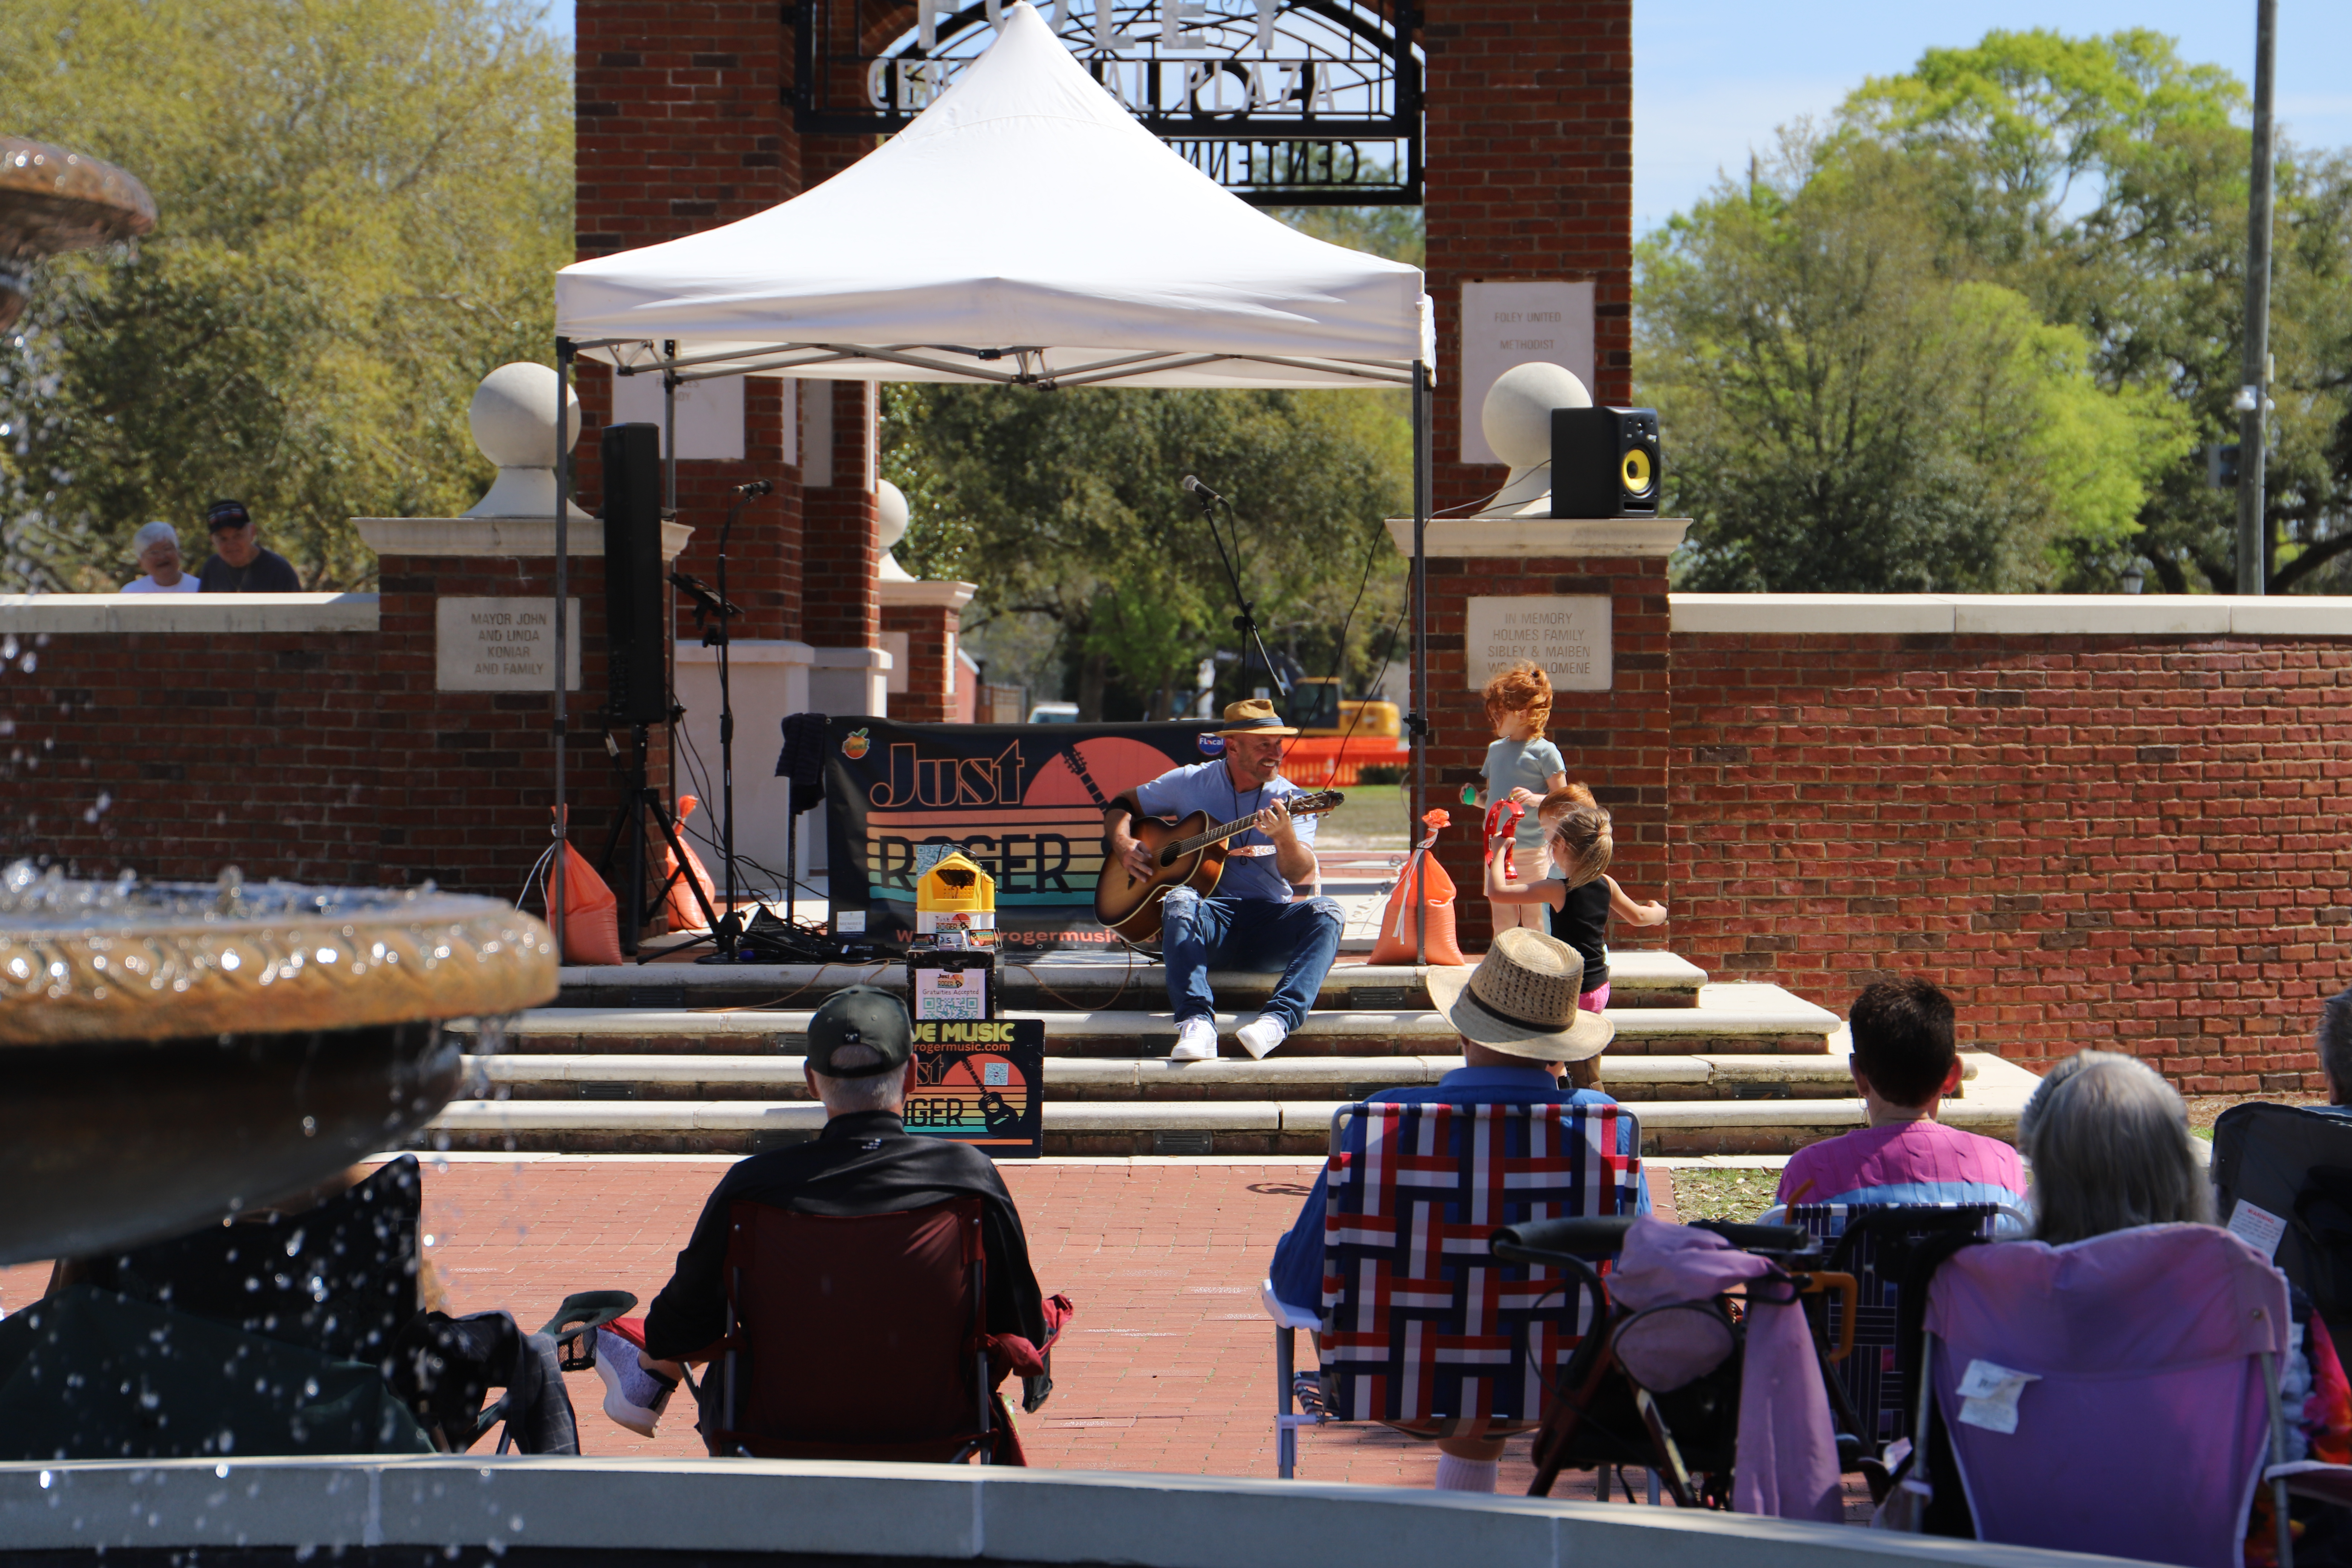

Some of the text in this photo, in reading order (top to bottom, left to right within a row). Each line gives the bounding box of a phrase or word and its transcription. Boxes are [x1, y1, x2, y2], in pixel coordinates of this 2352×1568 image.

[1183, 60, 1336, 111] PLAZA
[1495, 312, 1561, 322] FOLEY UNITED
[1500, 340, 1555, 349] METHODIST
[471, 613, 546, 625] MAYOR JOHN
[1505, 612, 1573, 624] IN MEMORY
[479, 630, 539, 641] AND LINDA
[1493, 629, 1585, 640] HOLMES FAMILY
[487, 646, 530, 658] KONIAR
[1488, 646, 1590, 657] SIBLEY & MAIBEN
[474, 663, 544, 675] AND FAMILY
[942, 1023, 1015, 1042] MUSIC
[2248, 1208, 2275, 1224] WARNING
